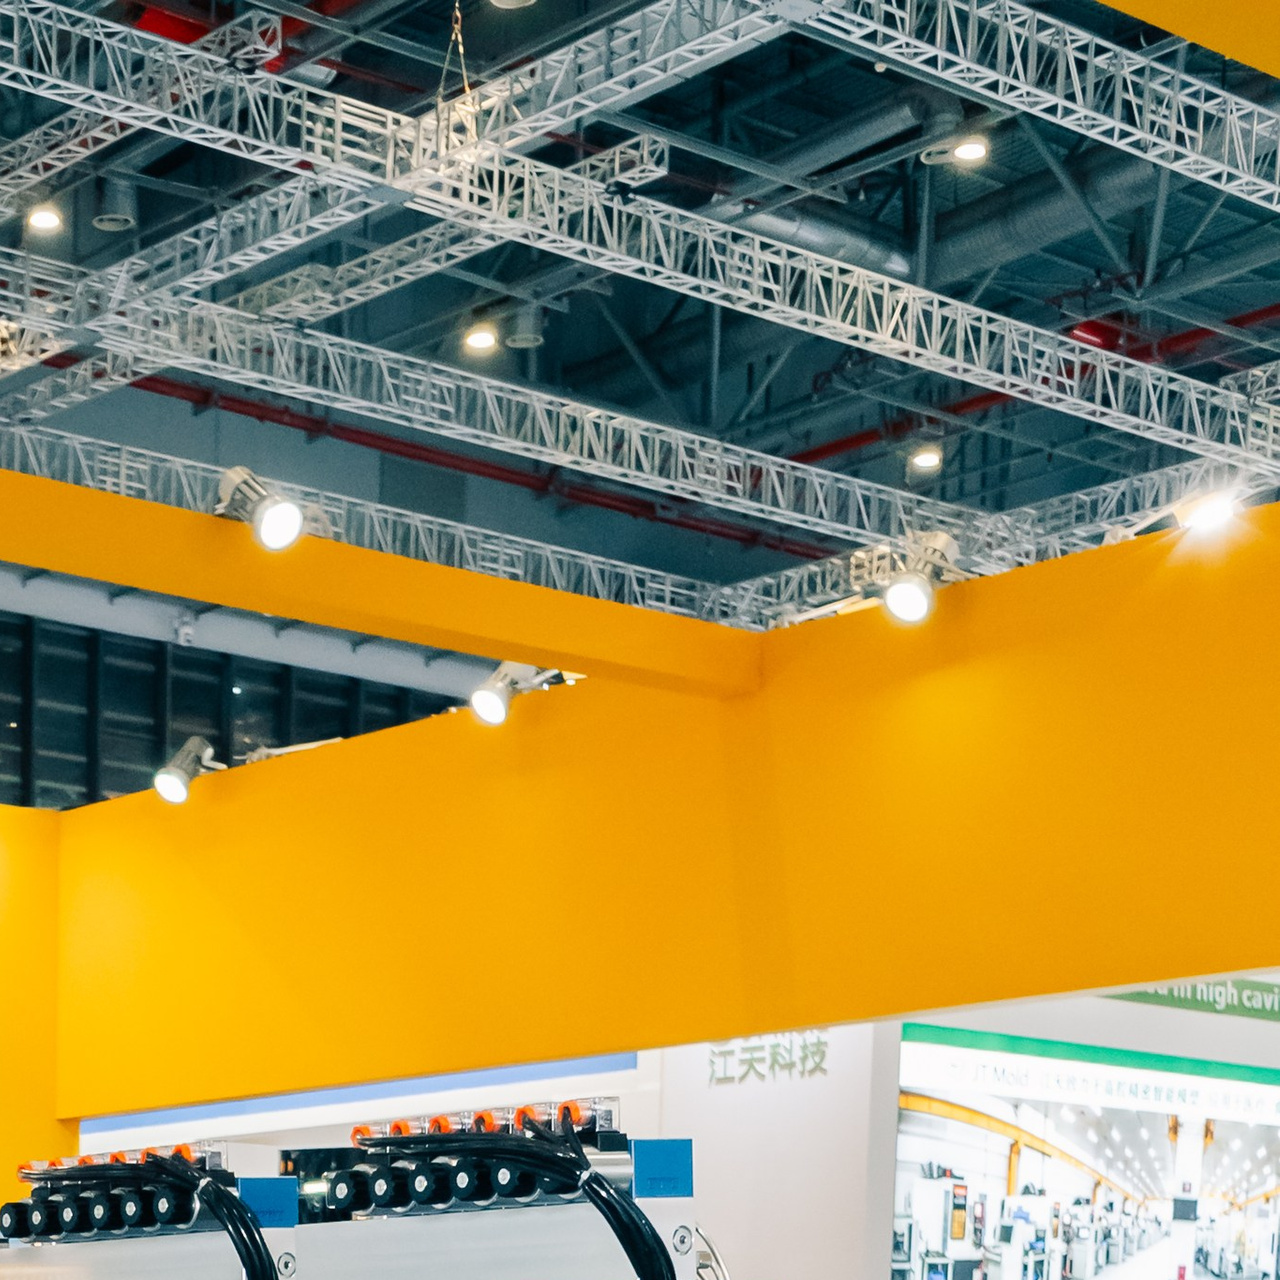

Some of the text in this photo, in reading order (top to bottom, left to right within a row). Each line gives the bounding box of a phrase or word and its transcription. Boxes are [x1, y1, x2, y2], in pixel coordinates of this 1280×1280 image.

[708, 1036, 829, 1089] 江天科技
[992, 1064, 1030, 1087] Mold
